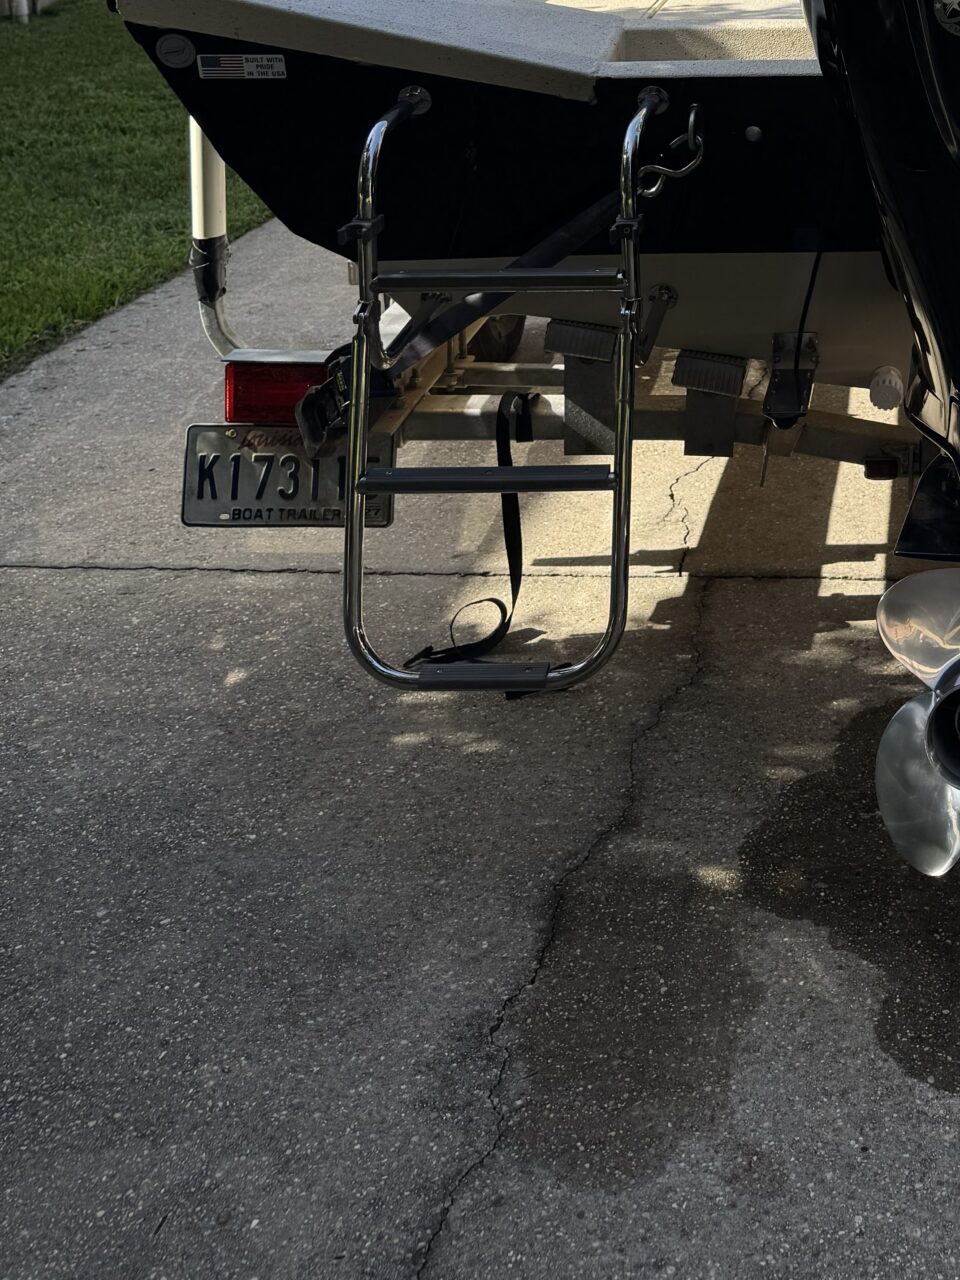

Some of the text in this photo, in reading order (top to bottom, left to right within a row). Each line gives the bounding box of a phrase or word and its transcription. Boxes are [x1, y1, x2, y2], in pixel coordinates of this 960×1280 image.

[237, 429, 305, 450] Louisia
[196, 453, 380, 500] K17311
[232, 508, 274, 520] BOAT
[279, 508, 342, 520] TRAILER
